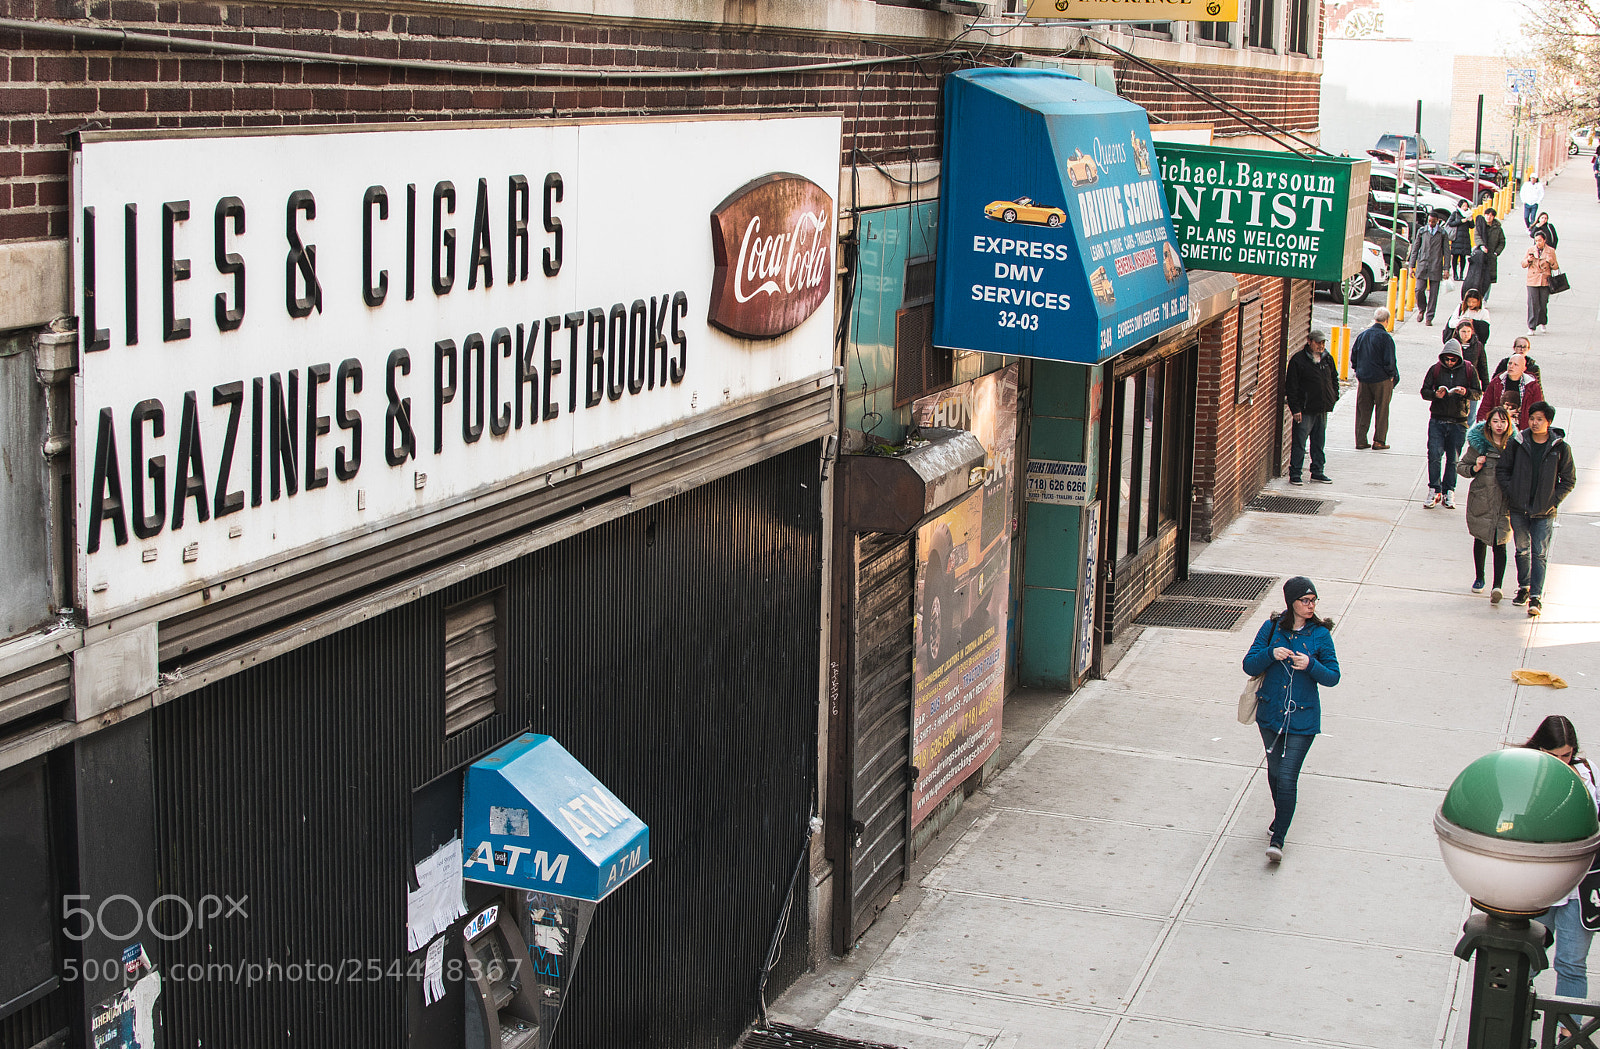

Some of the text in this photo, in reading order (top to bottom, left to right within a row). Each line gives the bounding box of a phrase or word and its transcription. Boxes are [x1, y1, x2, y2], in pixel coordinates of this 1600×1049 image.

[1093, 137, 1127, 174] Queens
[1157, 155, 1335, 194] ichael.Barsoum
[1077, 180, 1164, 238] DRIVING SCHOOL
[973, 235, 1068, 261] EXPRESS
[1186, 226, 1236, 244] PLANS
[1244, 230, 1320, 251] WELCOME
[84, 172, 564, 353] LIES & CIGARS
[994, 263, 1044, 283] DMV
[1238, 248, 1317, 270] DENTISTRY
[971, 284, 1071, 311] SERVICES
[998, 310, 1039, 331] 32-03
[1117, 317, 1134, 339] EXPRESS
[1134, 314, 1143, 332] DMV
[1143, 307, 1160, 327] SERVICES
[87, 291, 689, 554] AGAZINES & POCKETBOOKS
[1026, 478, 1087, 493] (718) 626 6260
[930, 696, 940, 716] BUS
[944, 684, 960, 704] TRUCK
[983, 648, 1000, 673] TRAILER
[948, 700, 961, 717] CLASS
[961, 705, 978, 737] (718)
[558, 786, 630, 847] ATM
[463, 840, 570, 884] ATM
[606, 845, 641, 888] ATM
